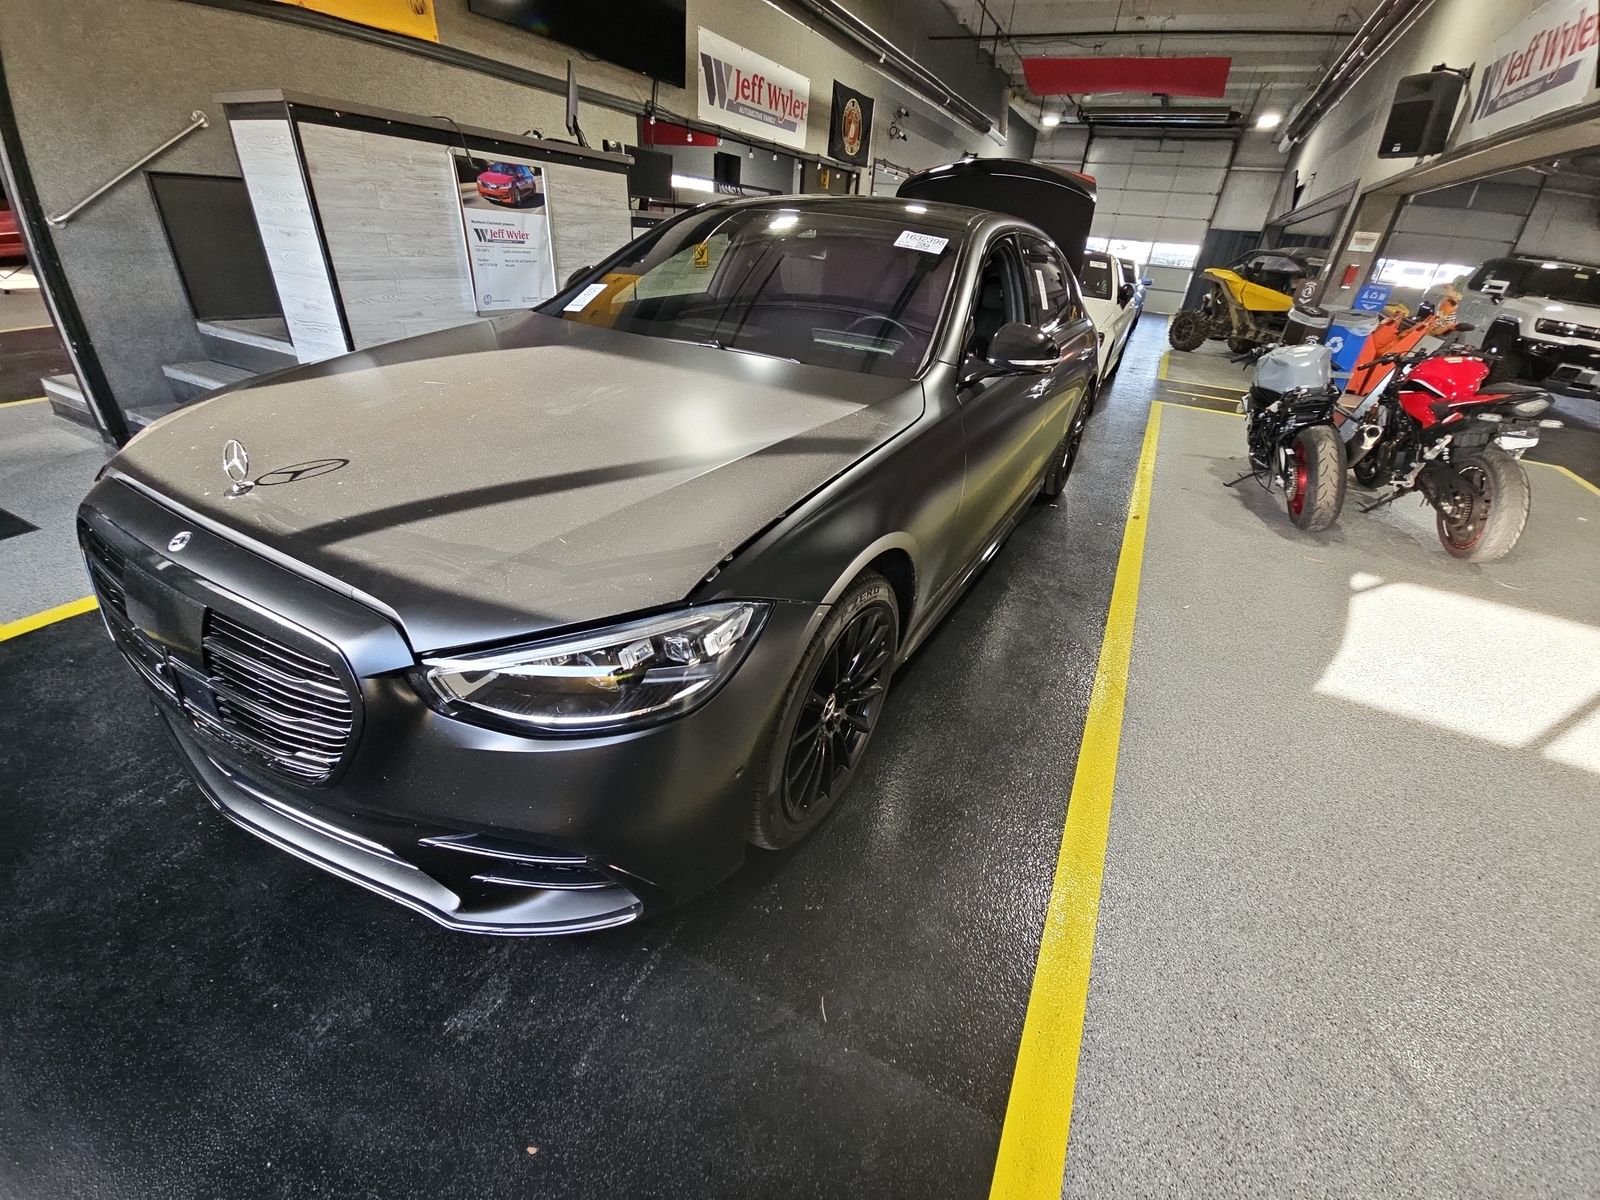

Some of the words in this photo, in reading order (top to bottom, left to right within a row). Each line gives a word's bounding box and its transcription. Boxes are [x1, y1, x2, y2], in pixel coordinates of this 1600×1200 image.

[1493, 29, 1546, 102] Jeff
[734, 69, 765, 106] Jeff
[767, 81, 807, 122] Wyler
[489, 228, 505, 240] Jeff
[506, 230, 530, 241] Wyler
[851, 585, 880, 612] ZERO
